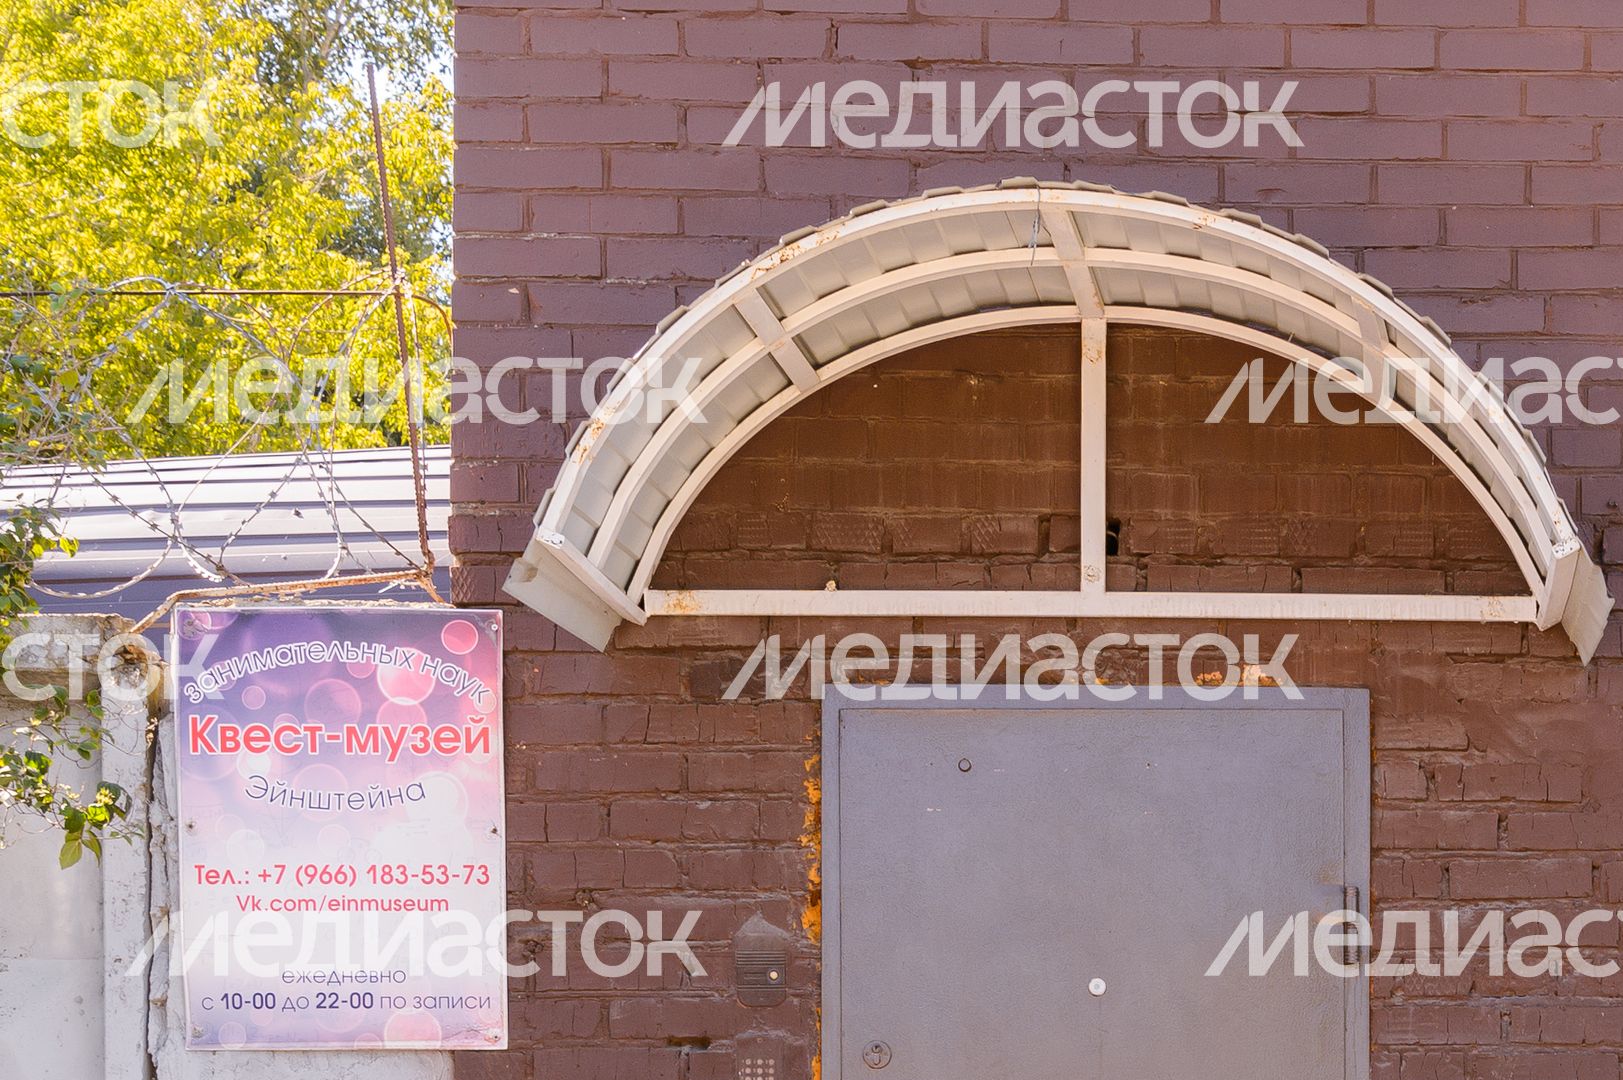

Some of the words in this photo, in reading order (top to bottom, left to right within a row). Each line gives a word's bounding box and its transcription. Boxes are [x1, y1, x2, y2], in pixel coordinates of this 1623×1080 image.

[184, 641, 415, 702] занимательных
[421, 655, 491, 704] наук
[189, 715, 491, 762] Квест-музей
[245, 774, 427, 811] Эйнштейна
[194, 864, 251, 885] Тел.:
[257, 864, 286, 885] +7
[295, 864, 357, 888] (966)
[366, 864, 490, 885] 183-53-73
[236, 895, 450, 914] Vk.com/einmuseum
[281, 969, 407, 986] ежедневно
[201, 996, 215, 1011] с
[220, 992, 276, 1010] 10-00
[281, 995, 309, 1012] до
[315, 992, 374, 1009] 22-00
[380, 994, 407, 1009] по
[412, 993, 492, 1009] записи
